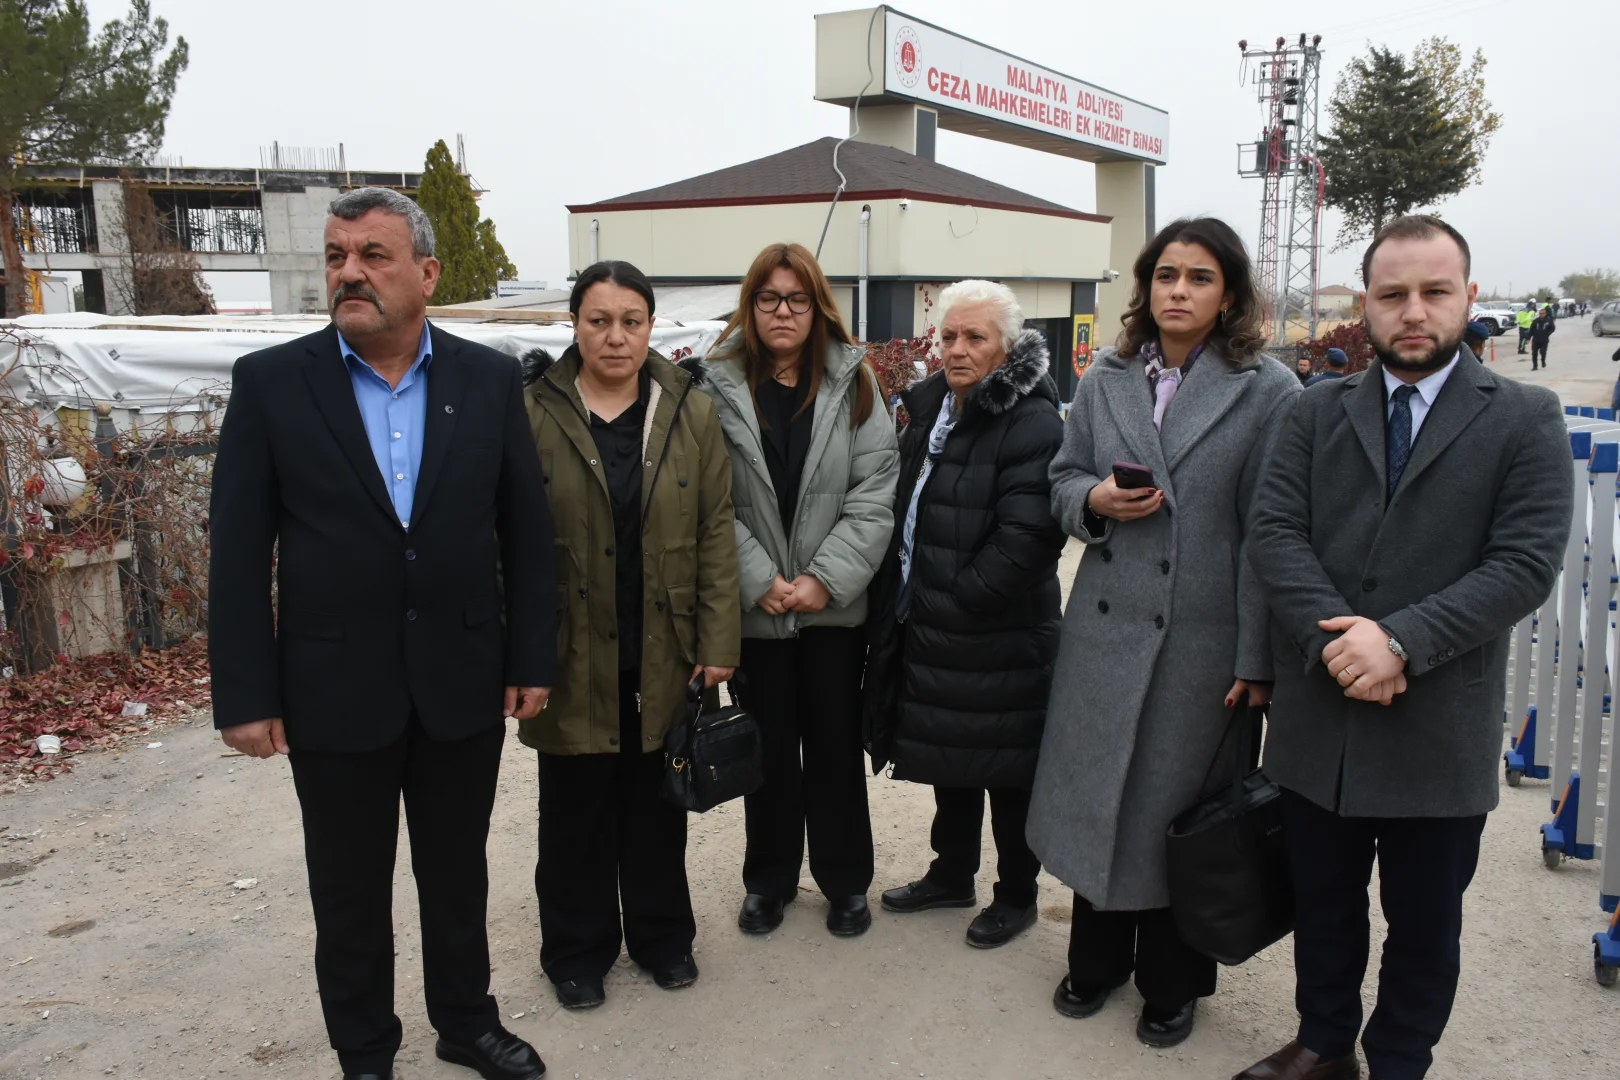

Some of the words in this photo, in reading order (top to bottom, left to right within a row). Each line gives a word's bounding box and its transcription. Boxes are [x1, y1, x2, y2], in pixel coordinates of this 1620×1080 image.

[927, 67, 971, 103] CEZA
[1076, 115, 1091, 134] EK
[1007, 65, 1067, 105] MALATYA
